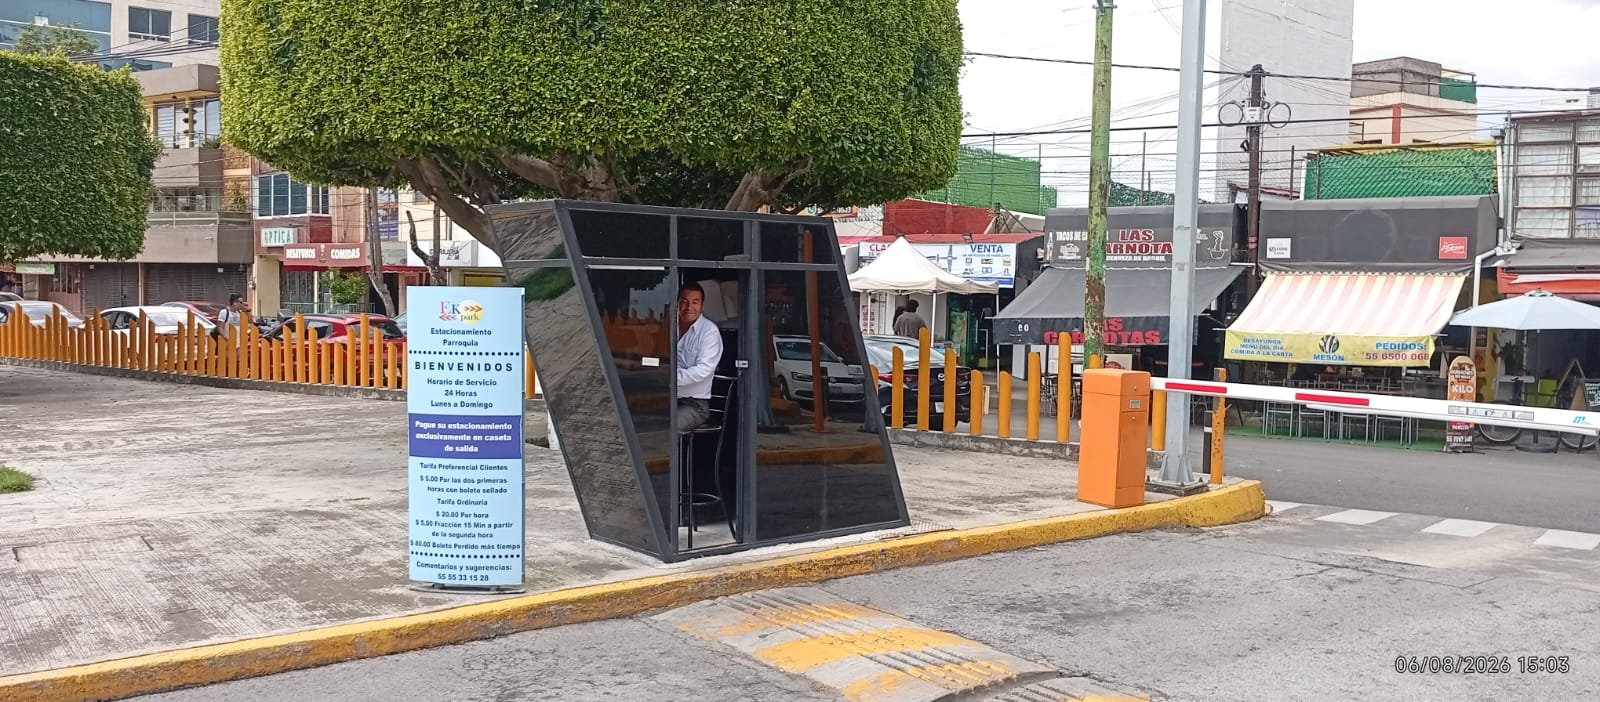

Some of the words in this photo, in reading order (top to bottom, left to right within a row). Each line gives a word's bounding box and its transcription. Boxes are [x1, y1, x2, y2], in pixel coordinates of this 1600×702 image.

[1120, 229, 1154, 241] LAS
[970, 244, 1004, 253] VENTA
[1106, 241, 1173, 255] ARNOTA
[331, 248, 360, 259] COMIDAS
[460, 313, 480, 322] park
[430, 328, 492, 336] Estacionamiento
[1043, 331, 1161, 345] CROTAS
[442, 339, 479, 348] Parroquia
[1375, 342, 1427, 351] PEDIDOS:
[1365, 352, 1378, 360] 55
[1381, 352, 1408, 361] 6500
[414, 361, 513, 372] BIENVENIDOS
[427, 378, 453, 386] Horario
[465, 378, 497, 386] Servicio
[455, 389, 478, 397] Horas
[1452, 385, 1474, 393] KILO
[430, 400, 452, 408] Lunes
[460, 400, 493, 409] Domingo
[415, 420, 436, 429] Pague
[447, 422, 513, 430] estacionamiento
[415, 432, 471, 441] exclusivamente
[444, 444, 454, 452] de
[455, 445, 479, 453] salida
[419, 462, 437, 470] Tarifa
[438, 463, 478, 471] Preferencial
[427, 485, 445, 493] horas
[434, 521, 462, 529] Fracción
[493, 522, 513, 530] partir
[432, 541, 453, 549] Boleto
[453, 542, 479, 550] Perdido
[416, 560, 457, 570] Comentarios
[465, 563, 513, 572] sugerencias:
[479, 574, 489, 582] 28
